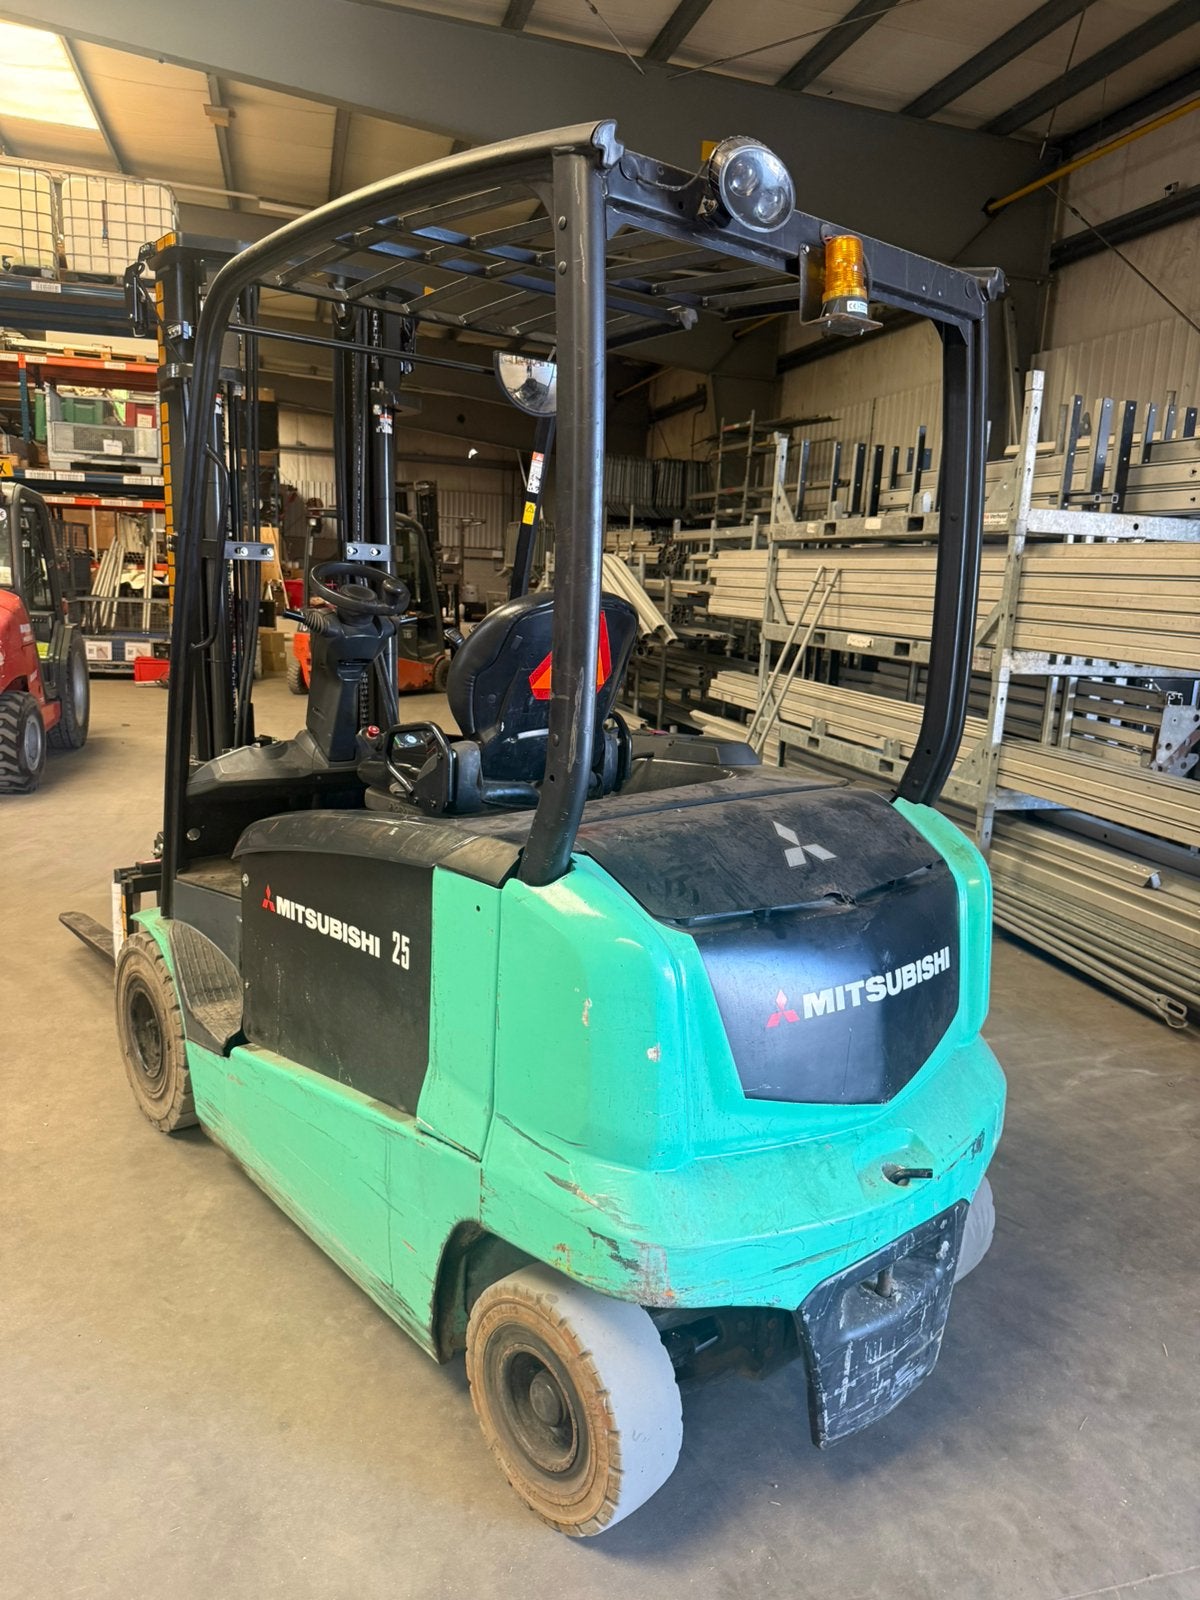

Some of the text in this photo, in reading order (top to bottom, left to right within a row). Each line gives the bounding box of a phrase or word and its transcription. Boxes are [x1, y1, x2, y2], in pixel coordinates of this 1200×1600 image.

[276, 895, 410, 970] MITSUBISHI 25
[802, 946, 951, 1019] MITSUBISHI
